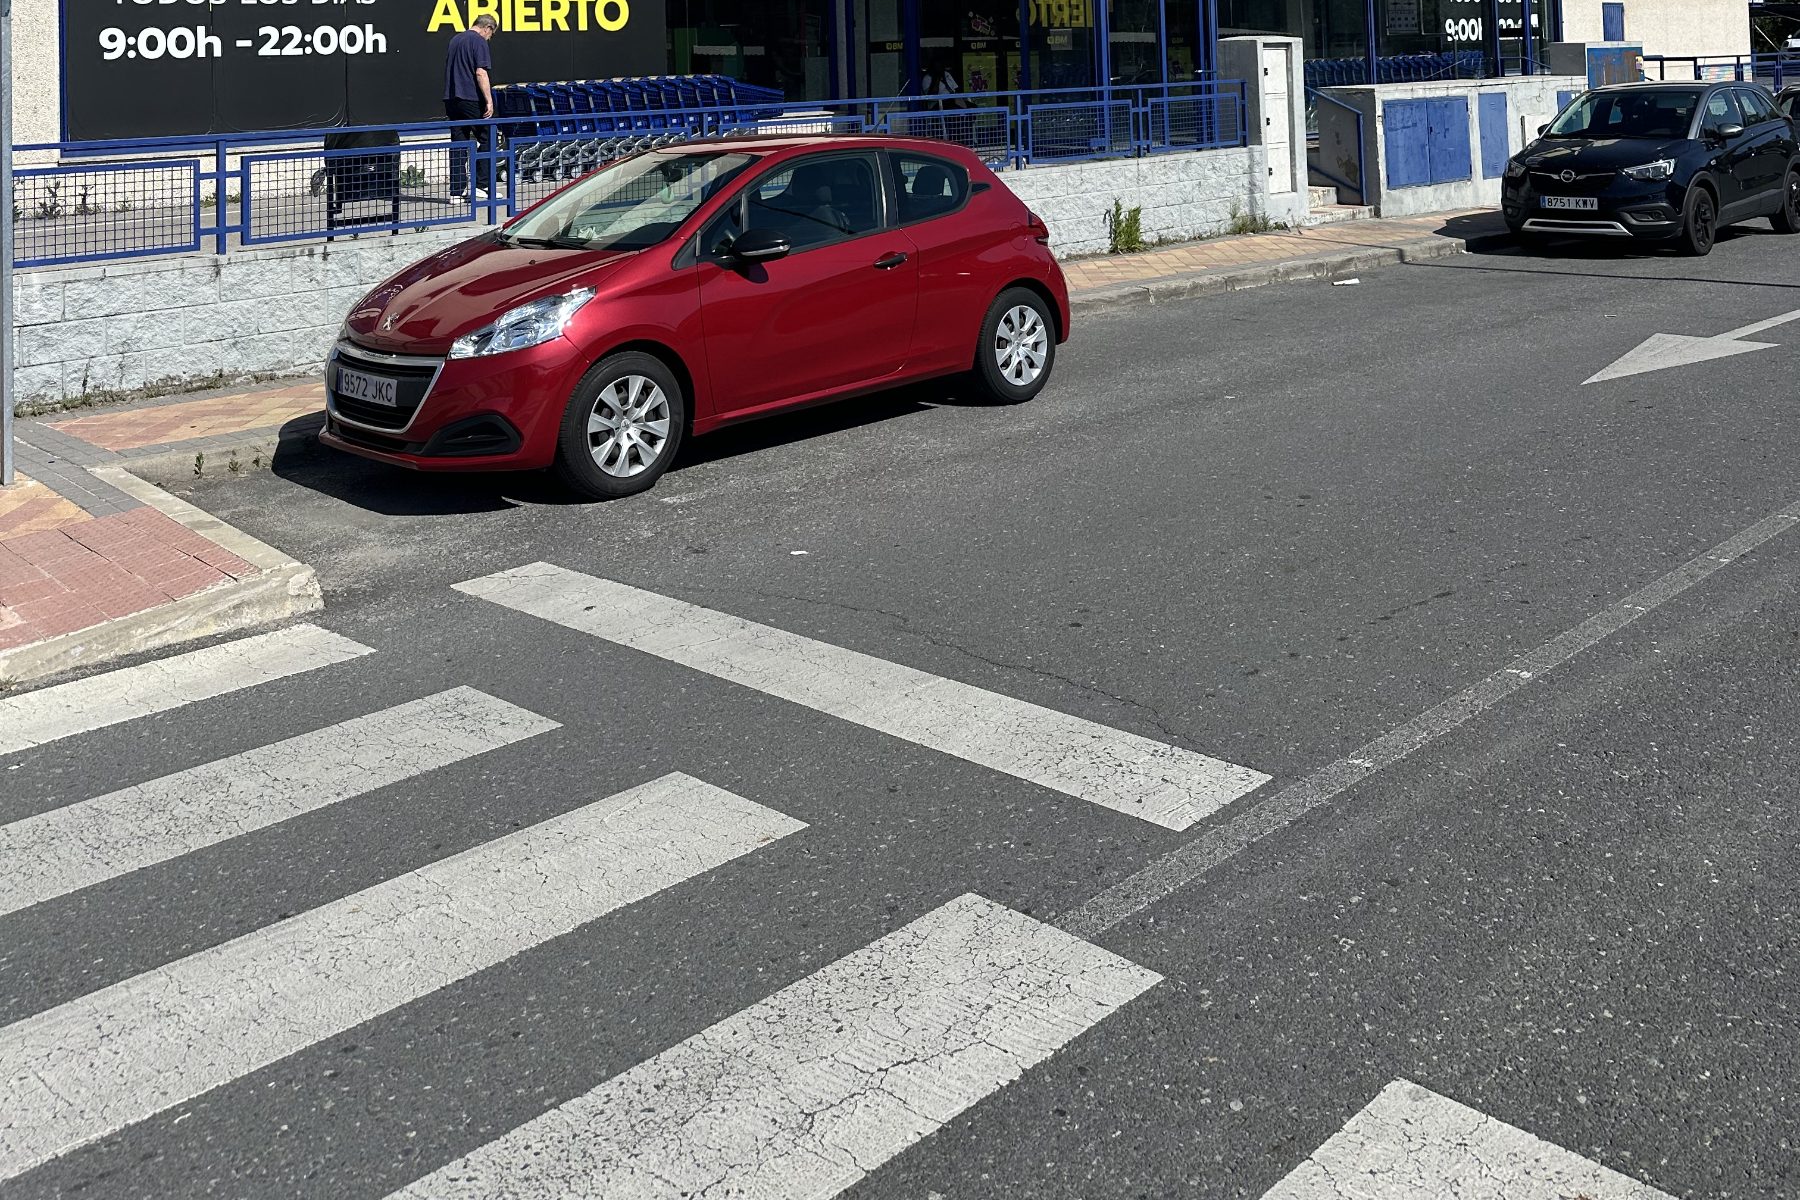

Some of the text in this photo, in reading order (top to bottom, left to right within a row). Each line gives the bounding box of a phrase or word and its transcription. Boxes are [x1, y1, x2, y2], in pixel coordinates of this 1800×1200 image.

[98, 25, 222, 61] 9:00h
[1547, 197, 1595, 208] 8751 KWV
[344, 373, 393, 402] 9572 JKC
